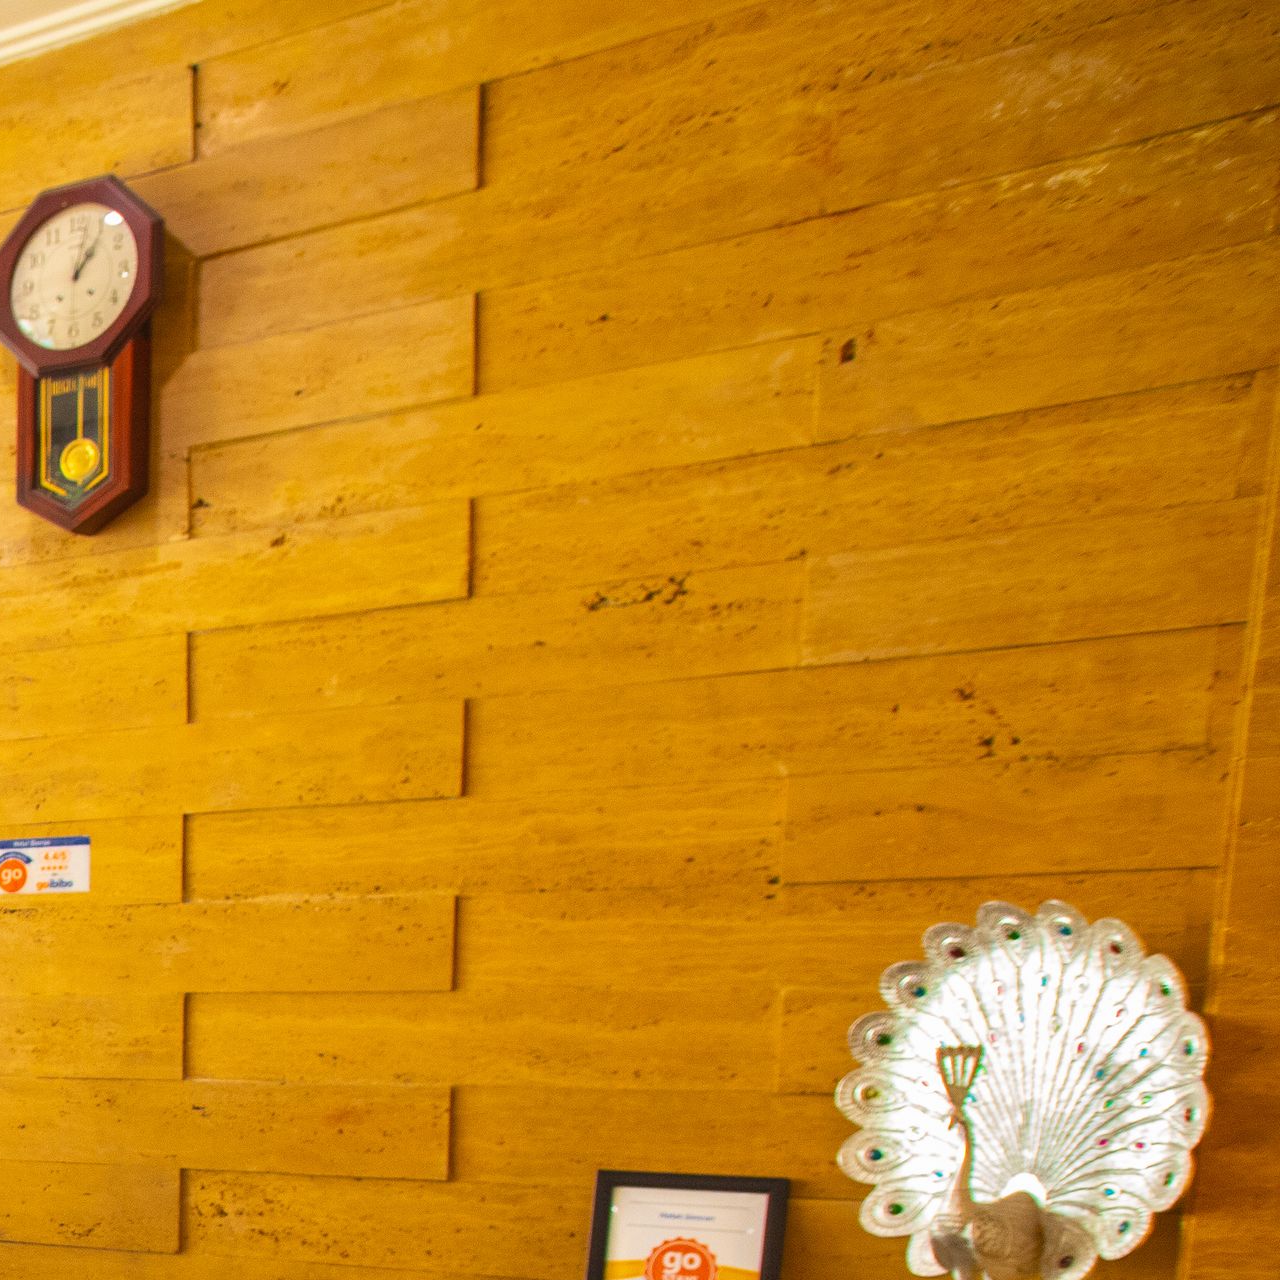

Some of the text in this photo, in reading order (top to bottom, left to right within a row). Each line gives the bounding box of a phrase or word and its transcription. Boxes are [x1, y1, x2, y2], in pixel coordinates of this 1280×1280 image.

[46, 228, 60, 246] 11
[113, 232, 124, 251] 2
[30, 250, 45, 269] 10
[22, 279, 34, 296] 9
[47, 318, 57, 336] 7
[91, 311, 104, 328] 5
[67, 321, 80, 337] 6
[0, 867, 23, 886] go
[662, 1251, 702, 1274] go
